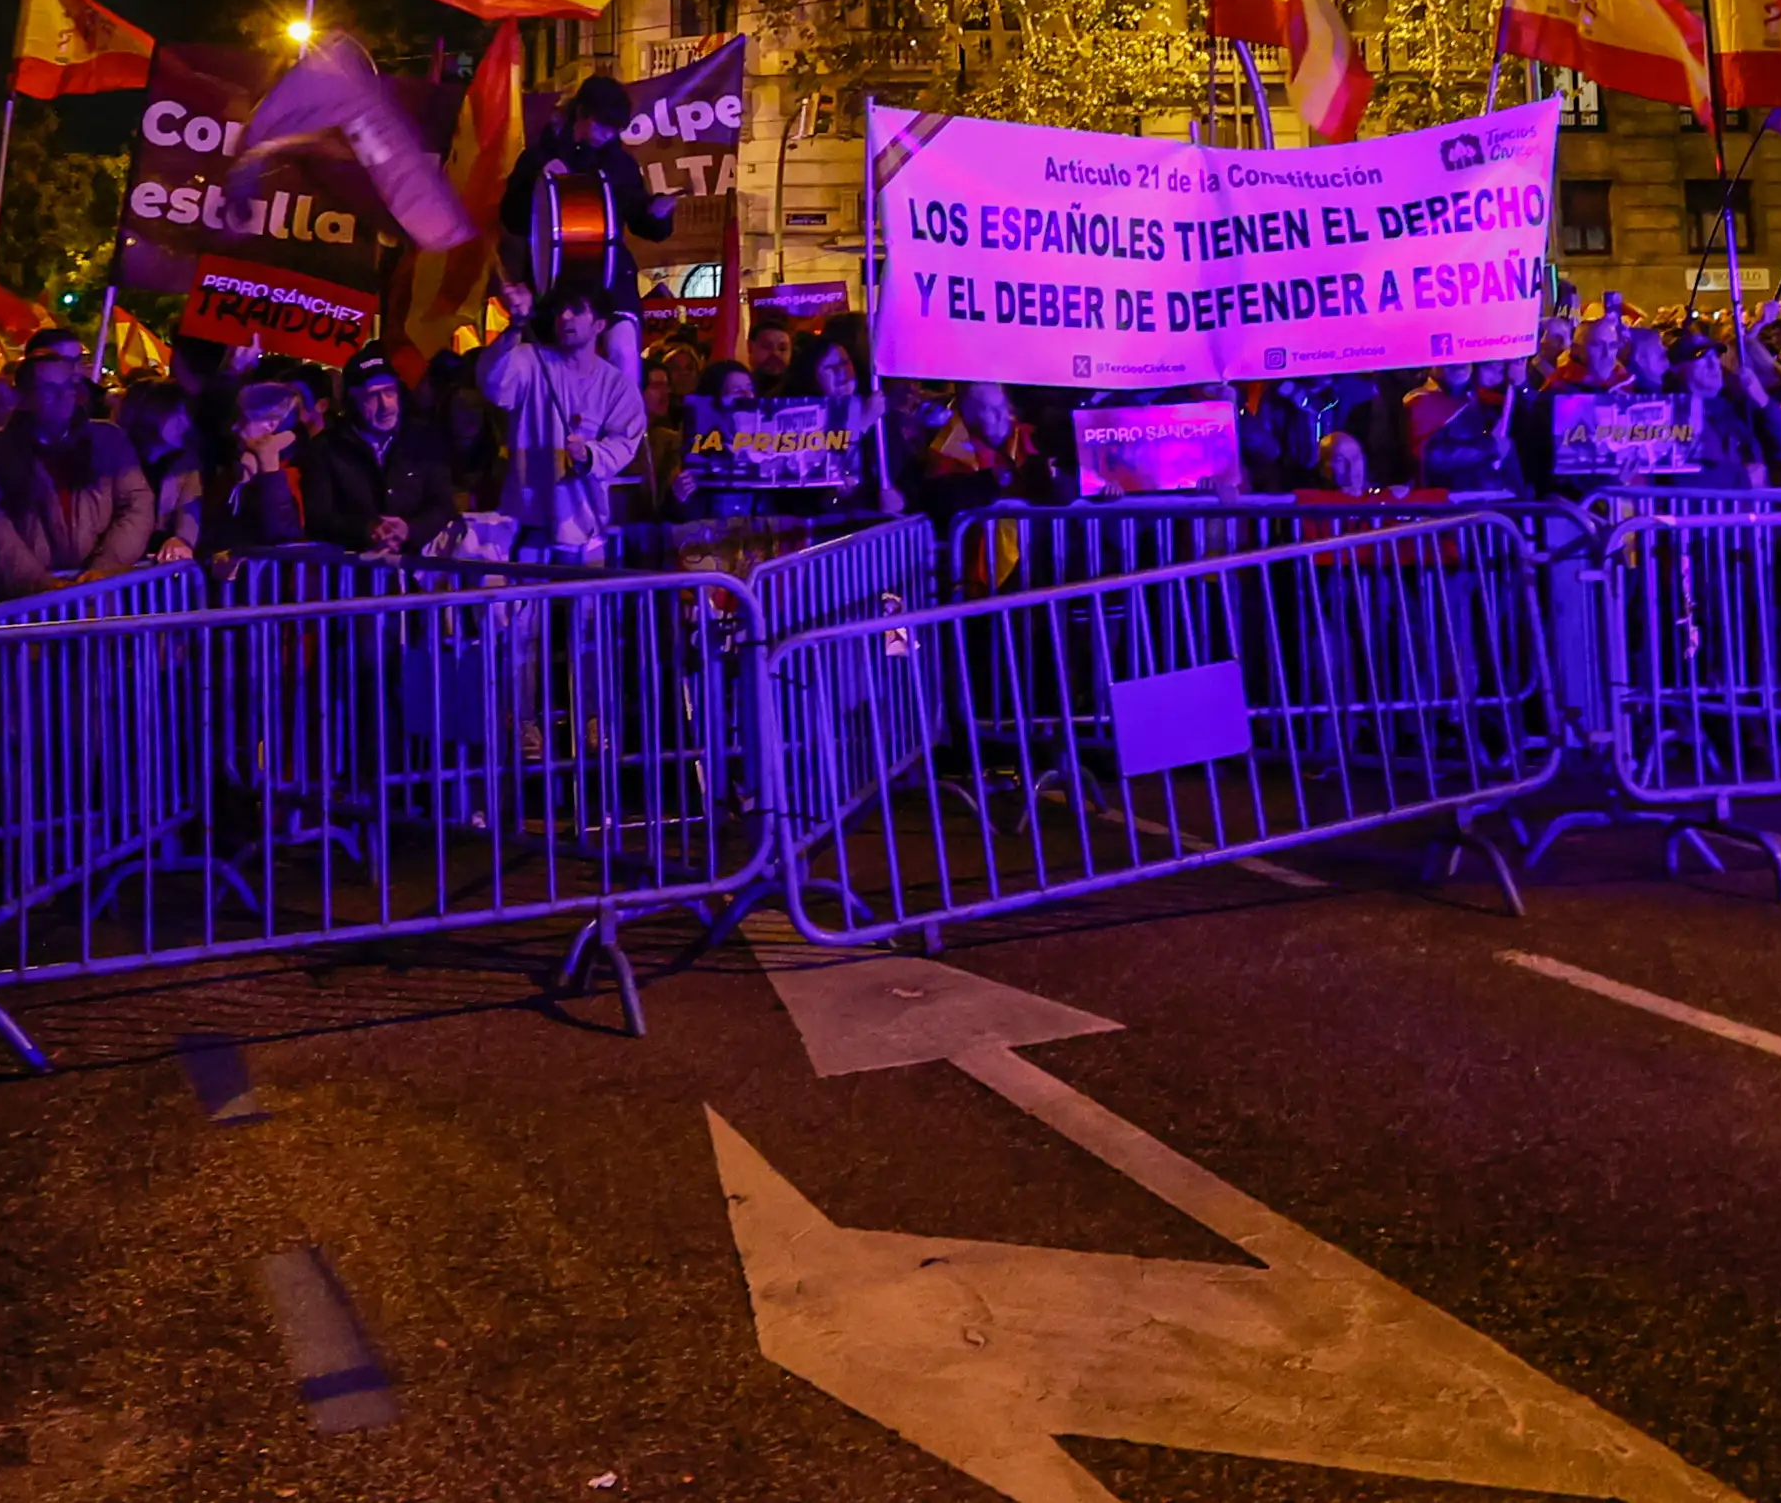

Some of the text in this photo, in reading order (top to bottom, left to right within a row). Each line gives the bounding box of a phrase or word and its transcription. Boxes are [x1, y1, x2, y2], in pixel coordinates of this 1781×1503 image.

[142, 100, 245, 157] Co
[620, 94, 742, 145] olpe
[1045, 156, 1383, 193] Artículo 21 de la Constitución
[129, 180, 356, 244] estalla
[908, 184, 1545, 263] LOS ESPAÑOLES TIENEN EL DERECHO
[196, 285, 363, 352] TRAIDOR
[202, 273, 366, 326] PEDRO SÁNCHEZ
[913, 248, 1544, 333] Y EL DEBER DE DEFENDER A ESPAÑA
[1084, 425, 1143, 444] PEDRO
